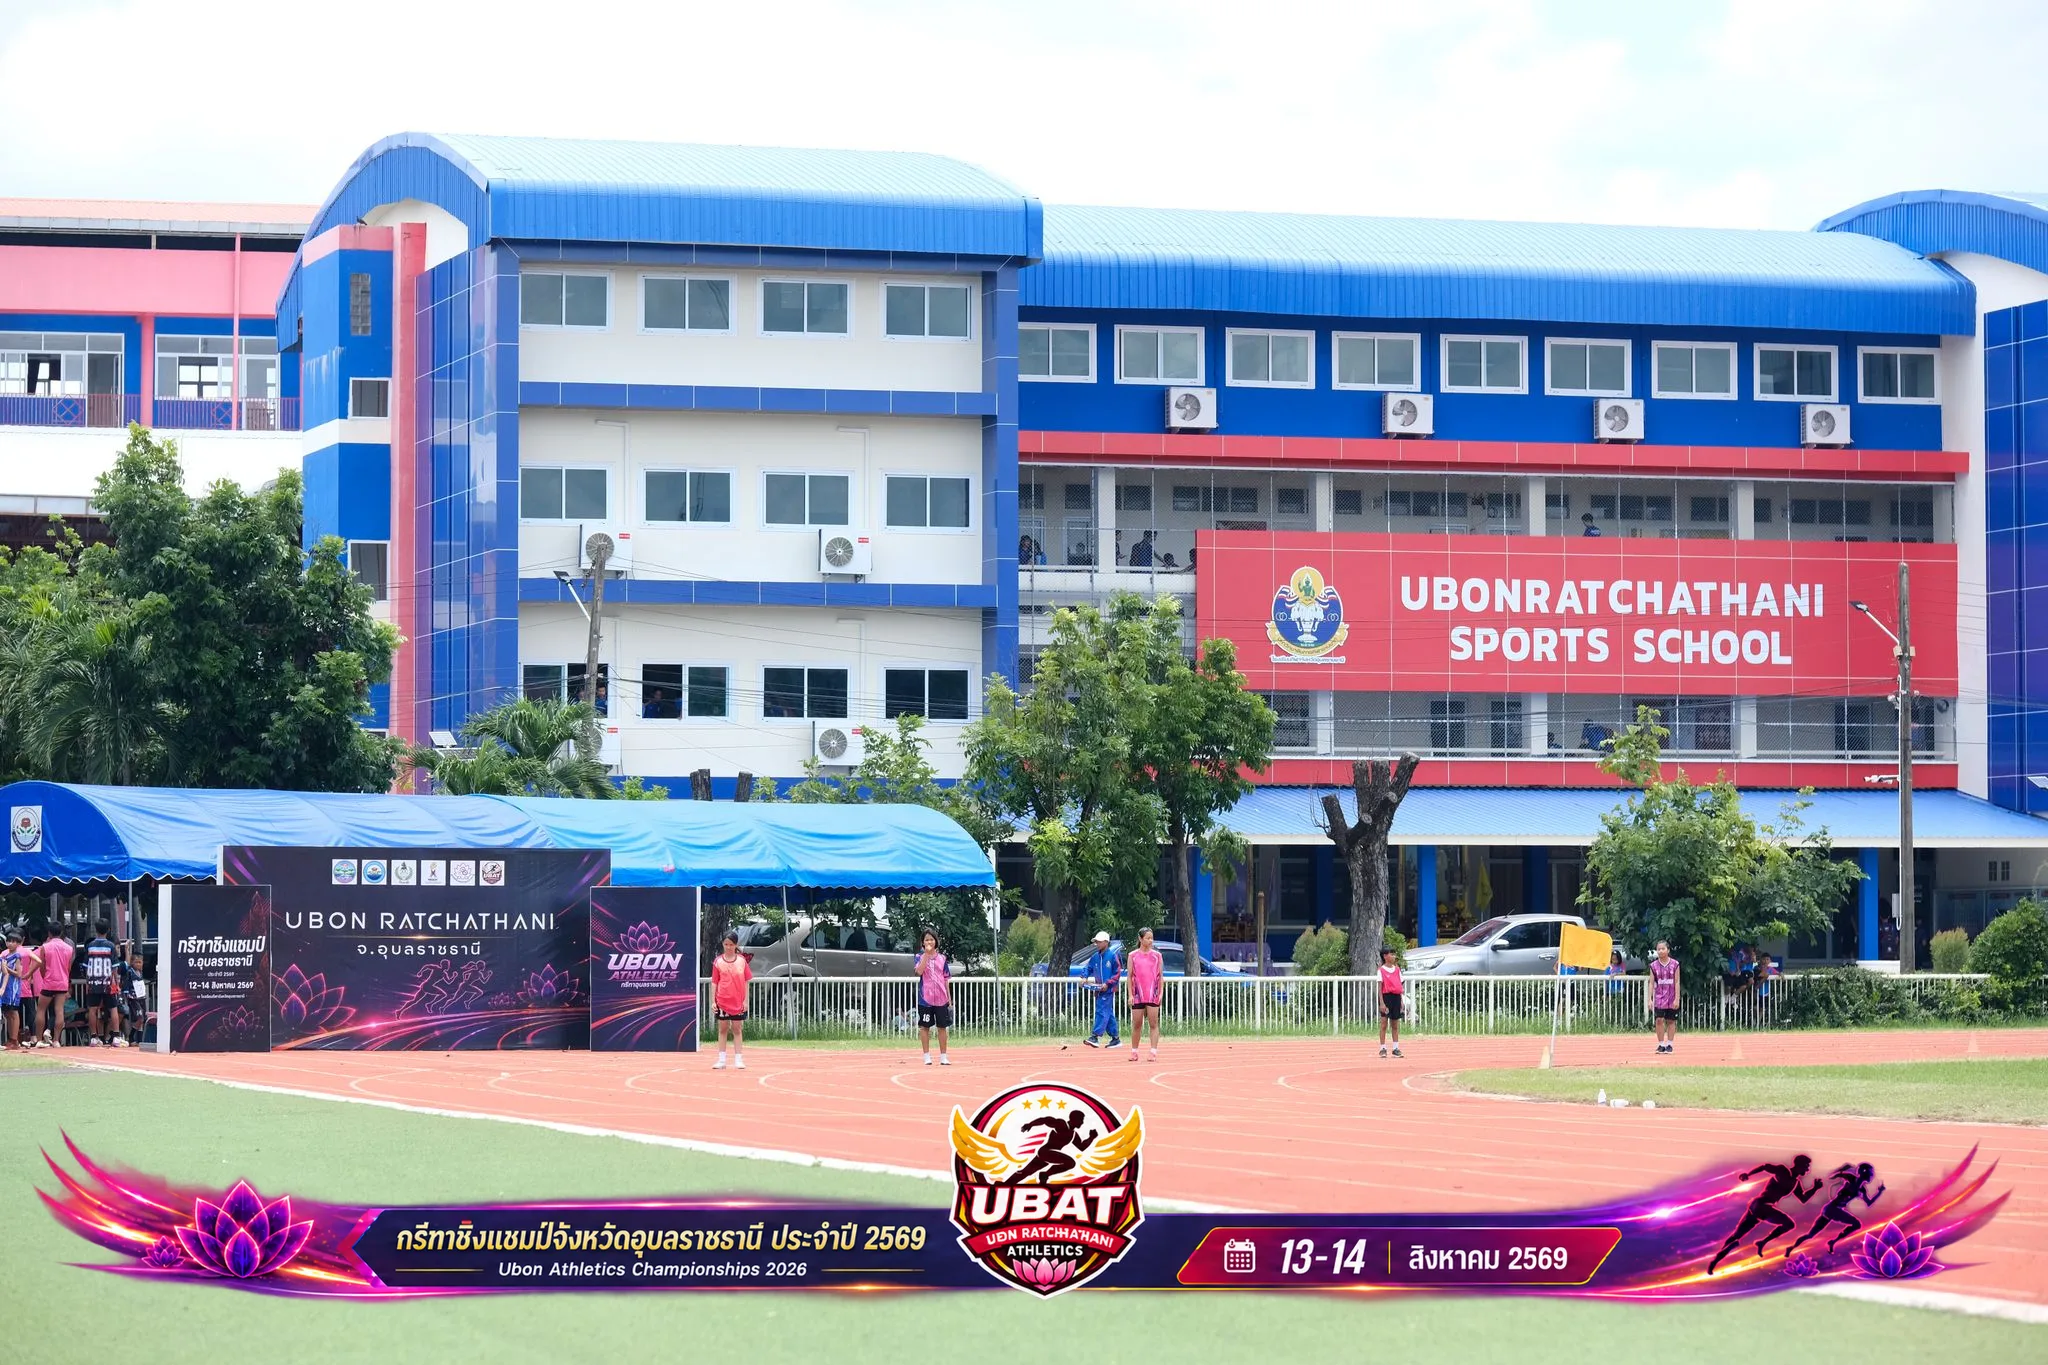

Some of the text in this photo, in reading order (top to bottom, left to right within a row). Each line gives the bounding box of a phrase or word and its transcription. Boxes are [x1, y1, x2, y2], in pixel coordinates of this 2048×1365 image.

[1400, 576, 1824, 617] UBONRATCHATHANI
[1450, 625, 1792, 665] SPORTS SCHOOL
[286, 911, 554, 930] UBON RATCHATHANI
[357, 941, 481, 960] จ.อุบลราชธานี
[188, 954, 253, 970] จ.อุบลราชธานี
[607, 953, 683, 970] UBON
[608, 970, 680, 980] ATHLETICS
[237, 981, 254, 989] 2569
[922, 1013, 931, 1022] 16
